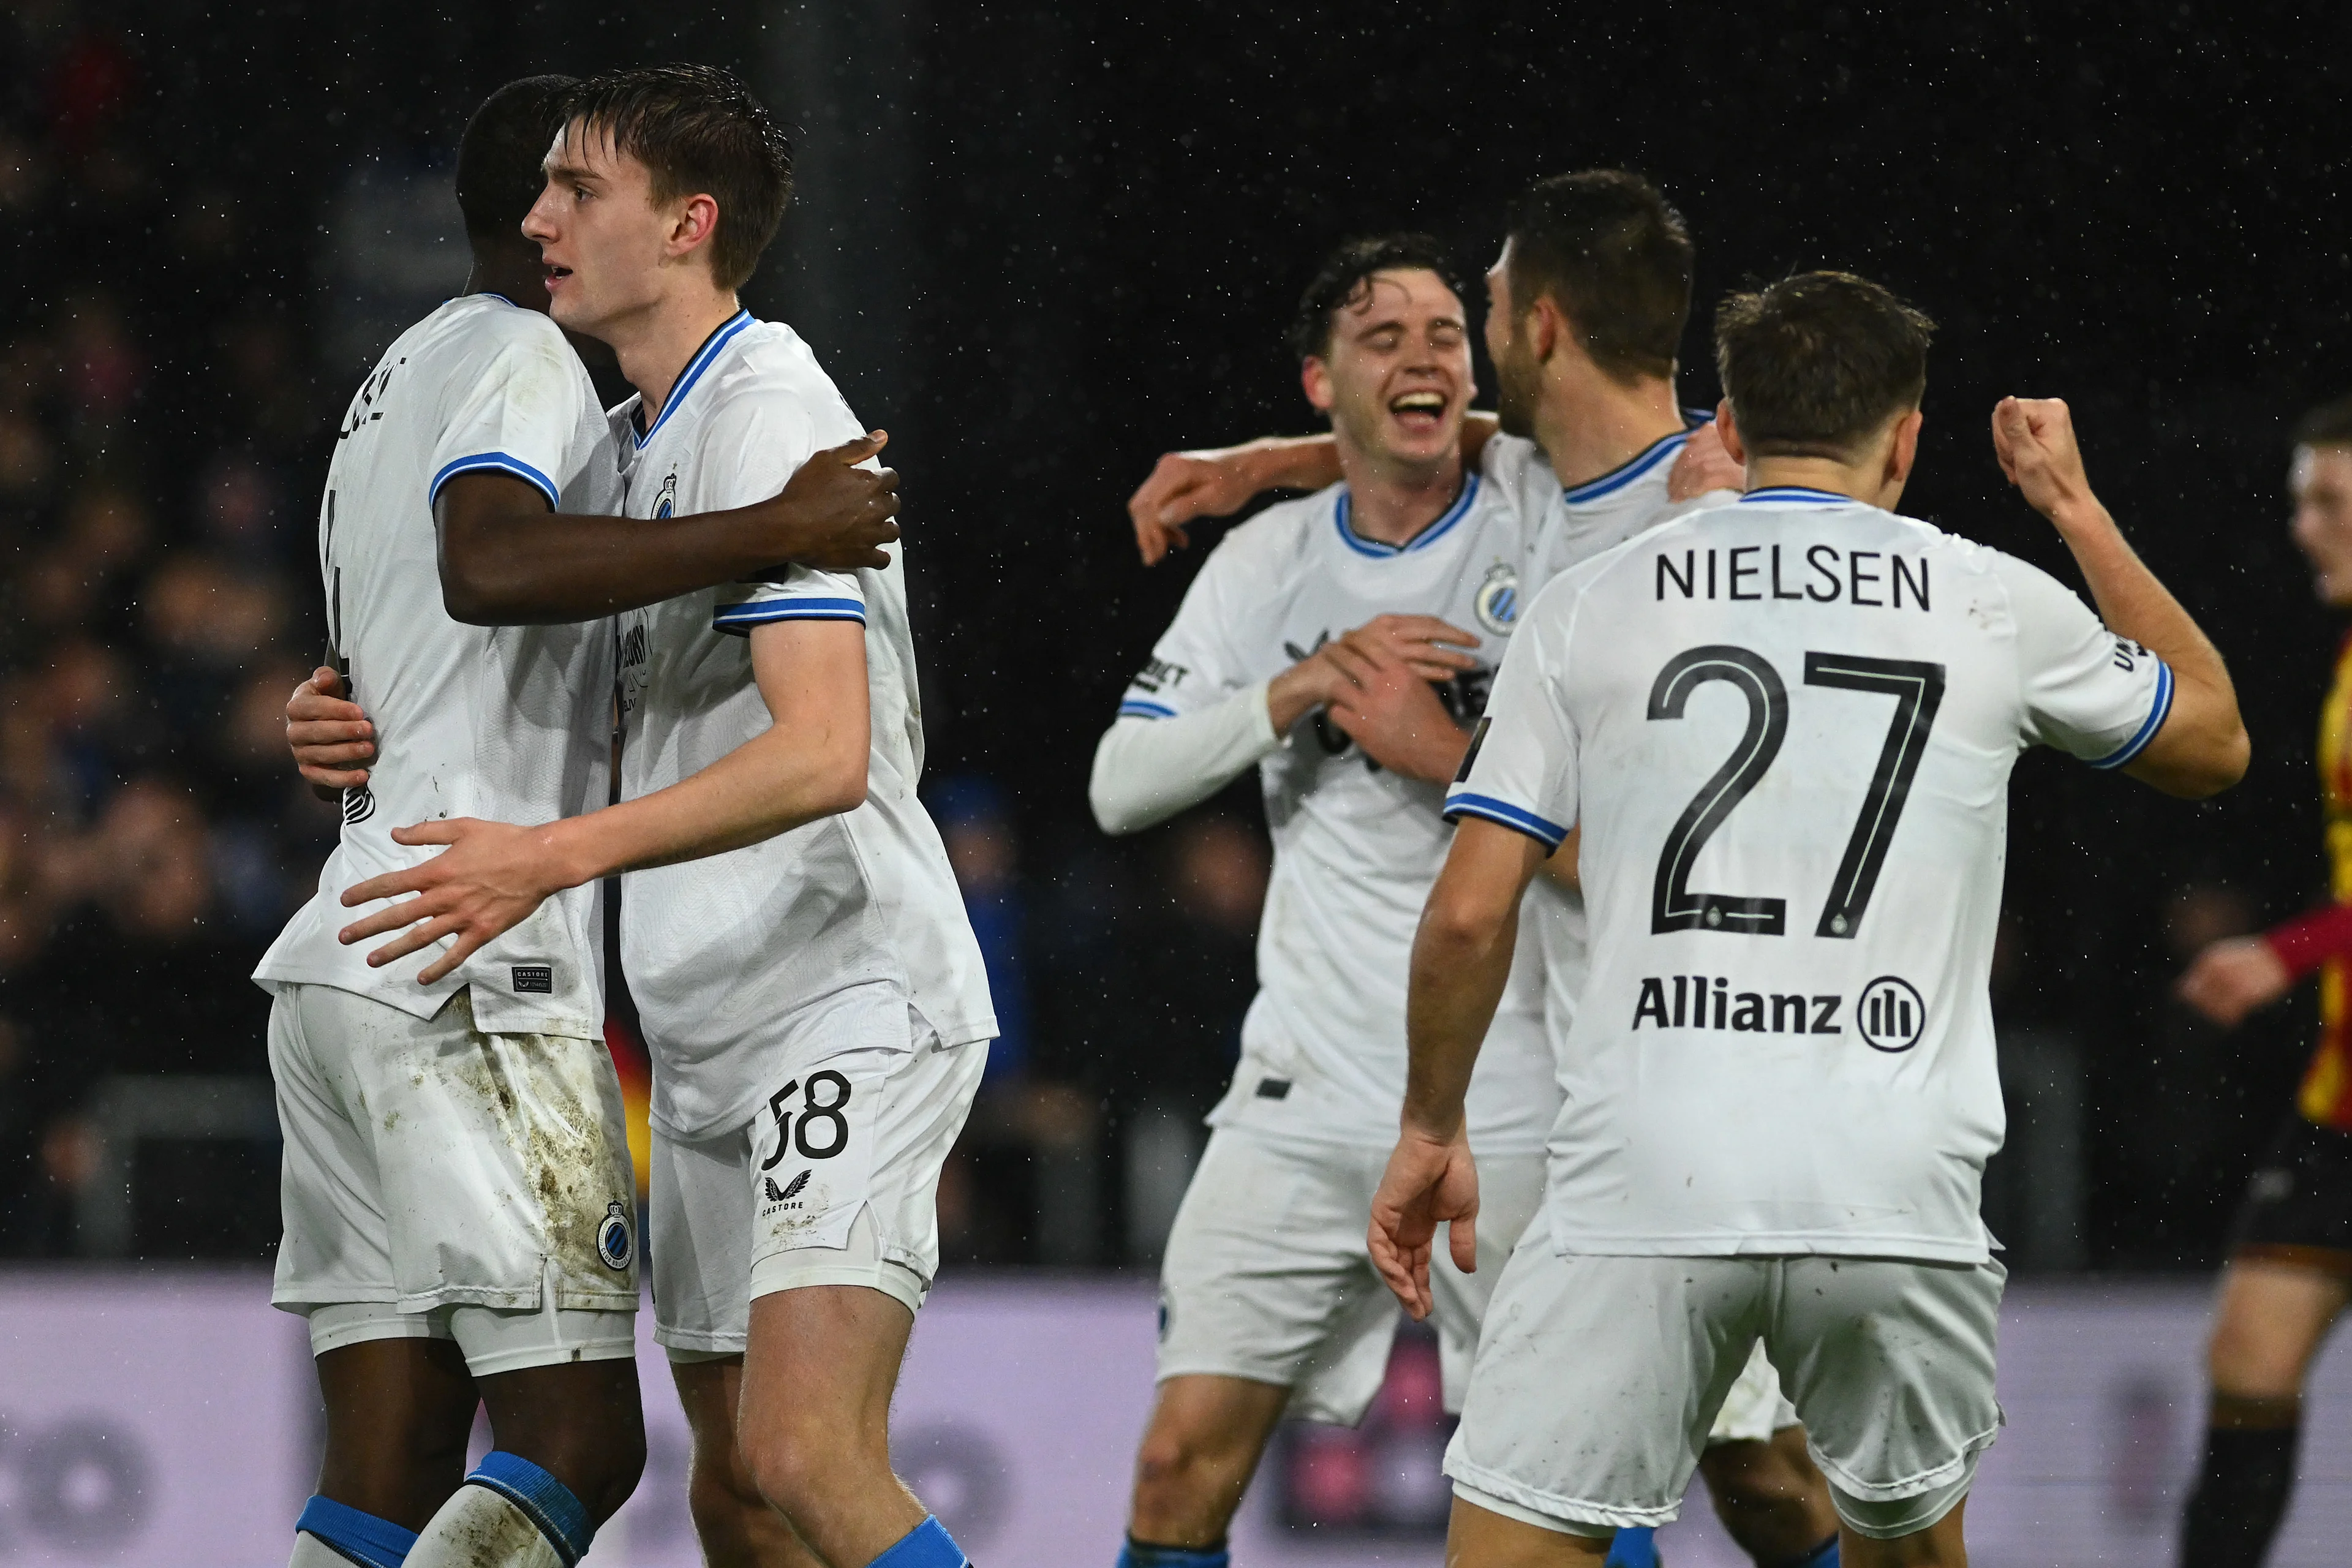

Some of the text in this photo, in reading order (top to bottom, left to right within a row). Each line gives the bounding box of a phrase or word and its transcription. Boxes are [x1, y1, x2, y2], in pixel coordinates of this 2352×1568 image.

[1656, 544, 1931, 612] NIELSEN
[1646, 644, 1947, 939] 27
[1632, 976, 1842, 1034] Allianz
[761, 1069, 852, 1171] 58
[762, 1202, 804, 1217] CASTORE
[601, 1247, 612, 1263] CLUB
[612, 1256, 628, 1267] BRUGGE
